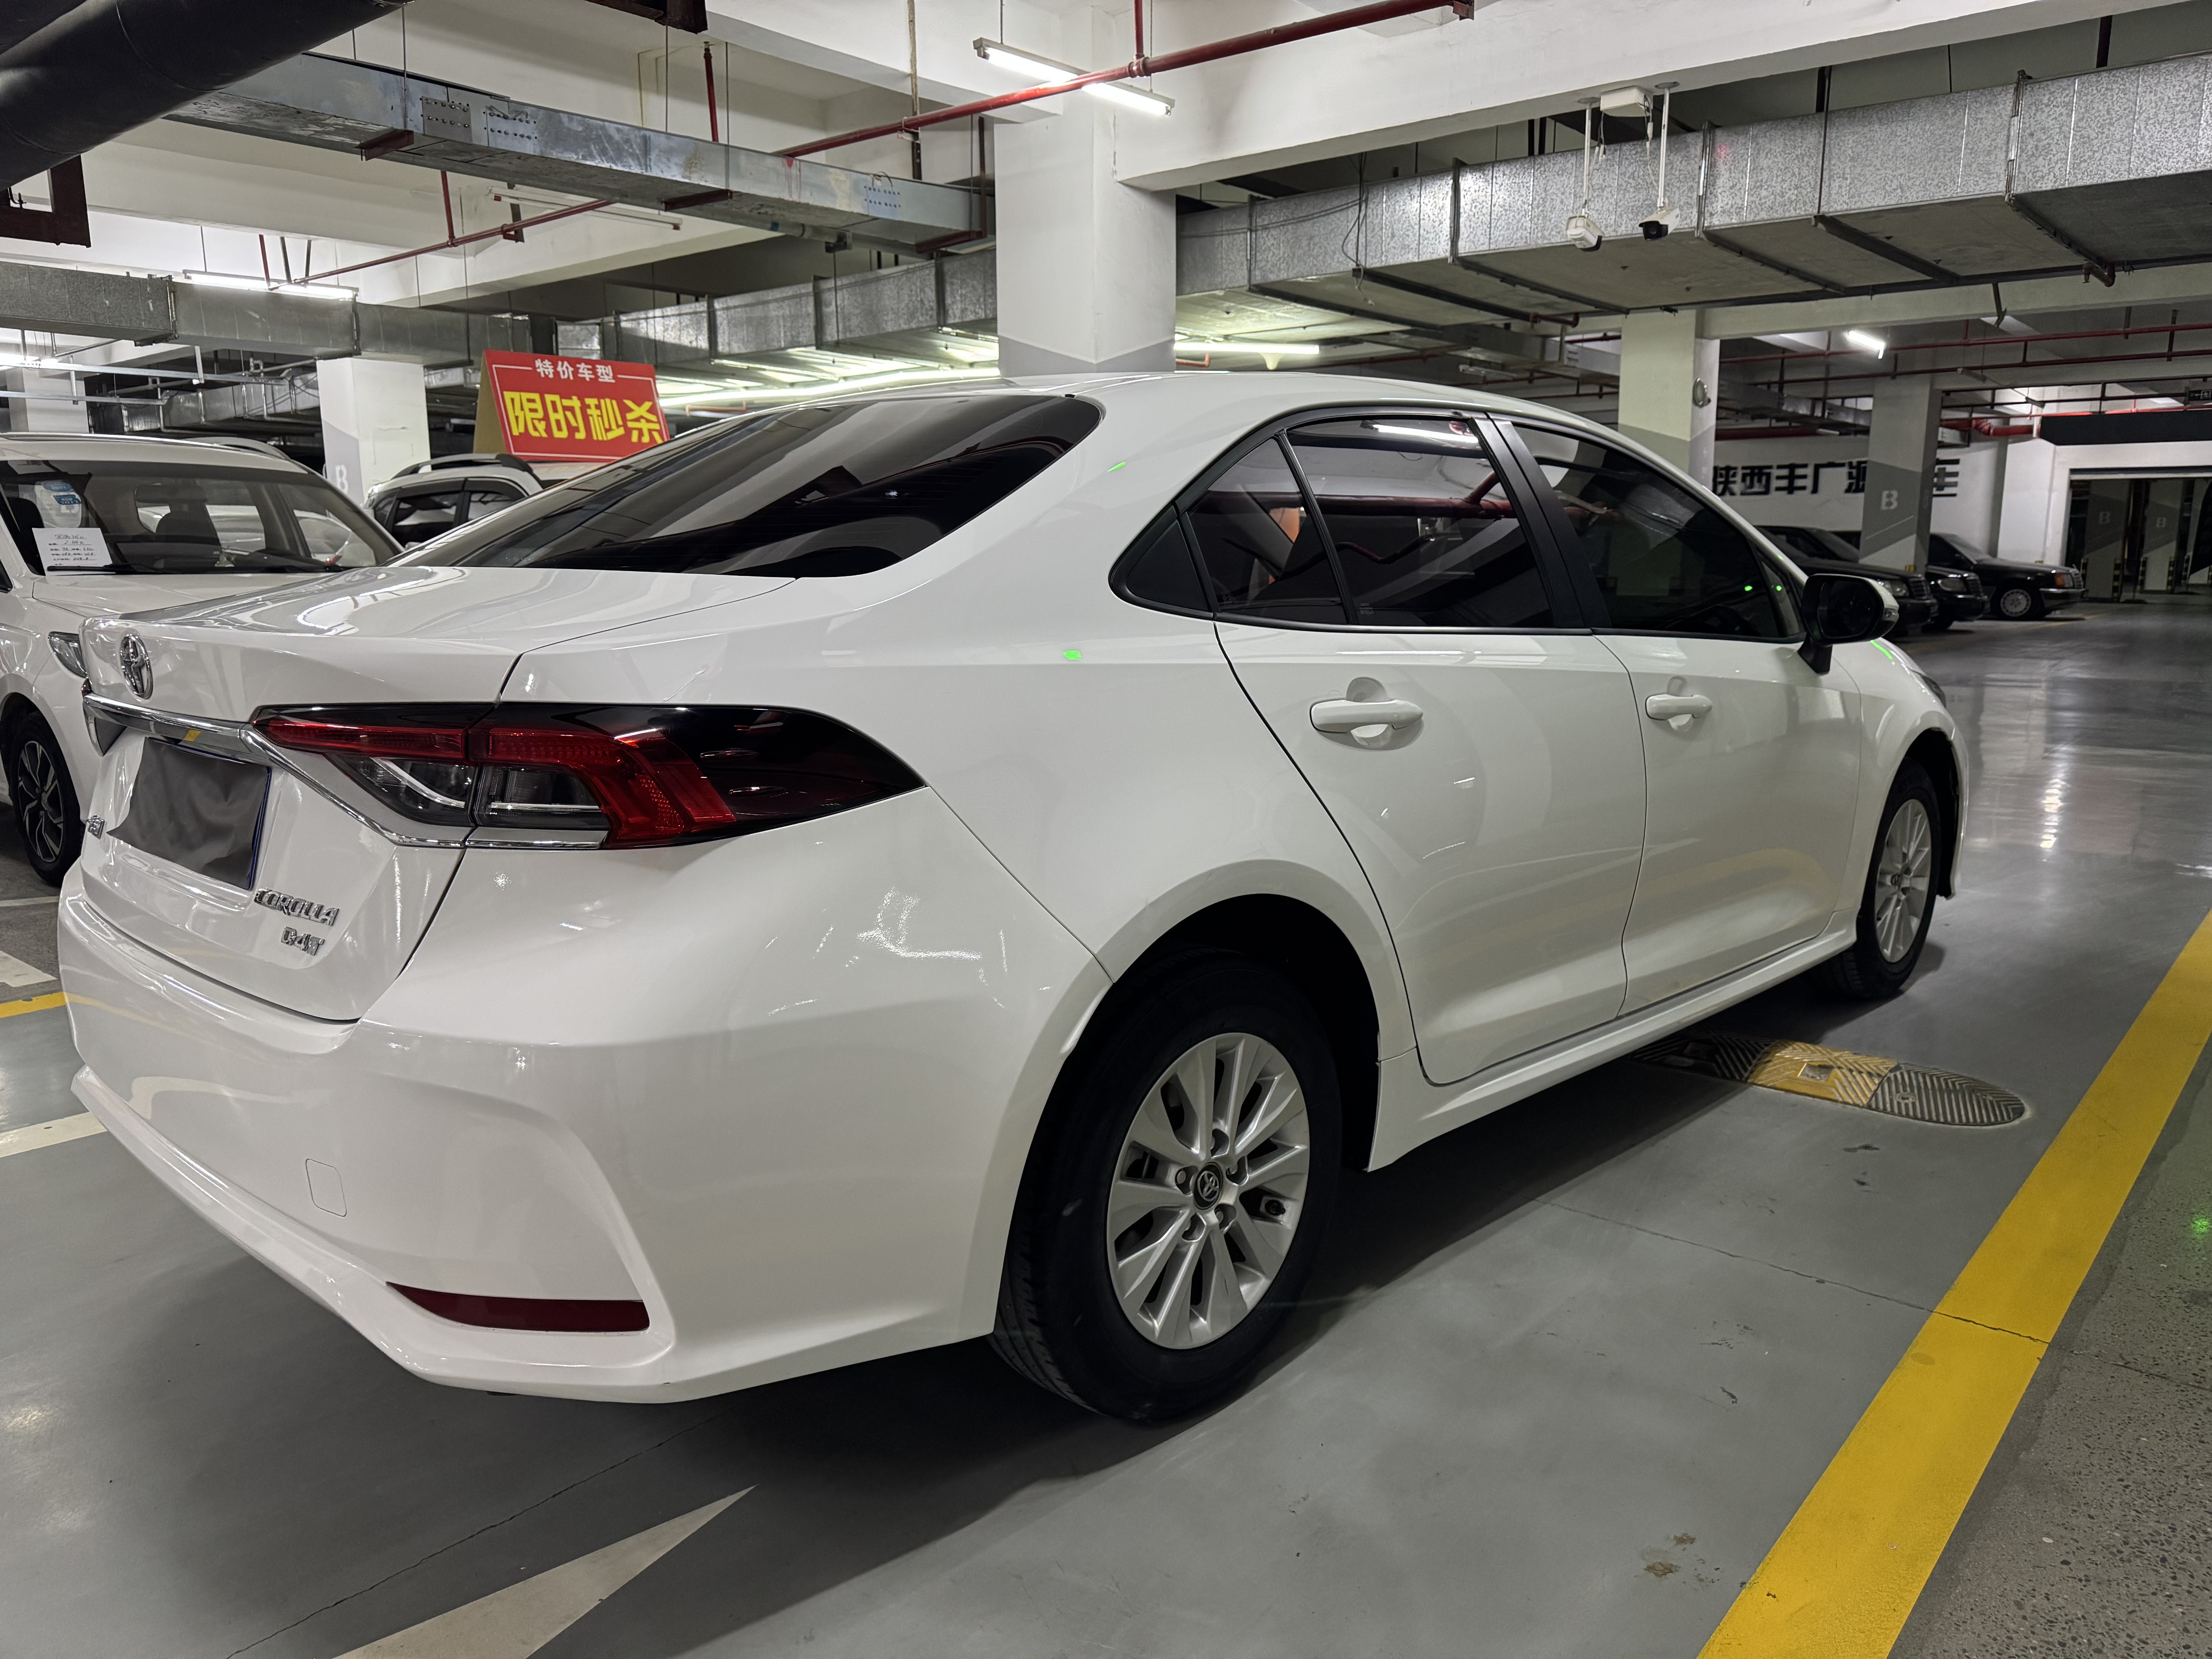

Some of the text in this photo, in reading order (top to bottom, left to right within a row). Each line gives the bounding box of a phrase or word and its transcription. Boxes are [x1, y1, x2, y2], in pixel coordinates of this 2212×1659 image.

[535, 358, 616, 383] 特价车型
[503, 391, 663, 444] 限时秒杀
[1712, 458, 1960, 496] 陕西丰广源车
[1881, 490, 1898, 511] B
[2098, 511, 2111, 524] B
[2156, 517, 2167, 528] B
[254, 888, 340, 926] COROLLA
